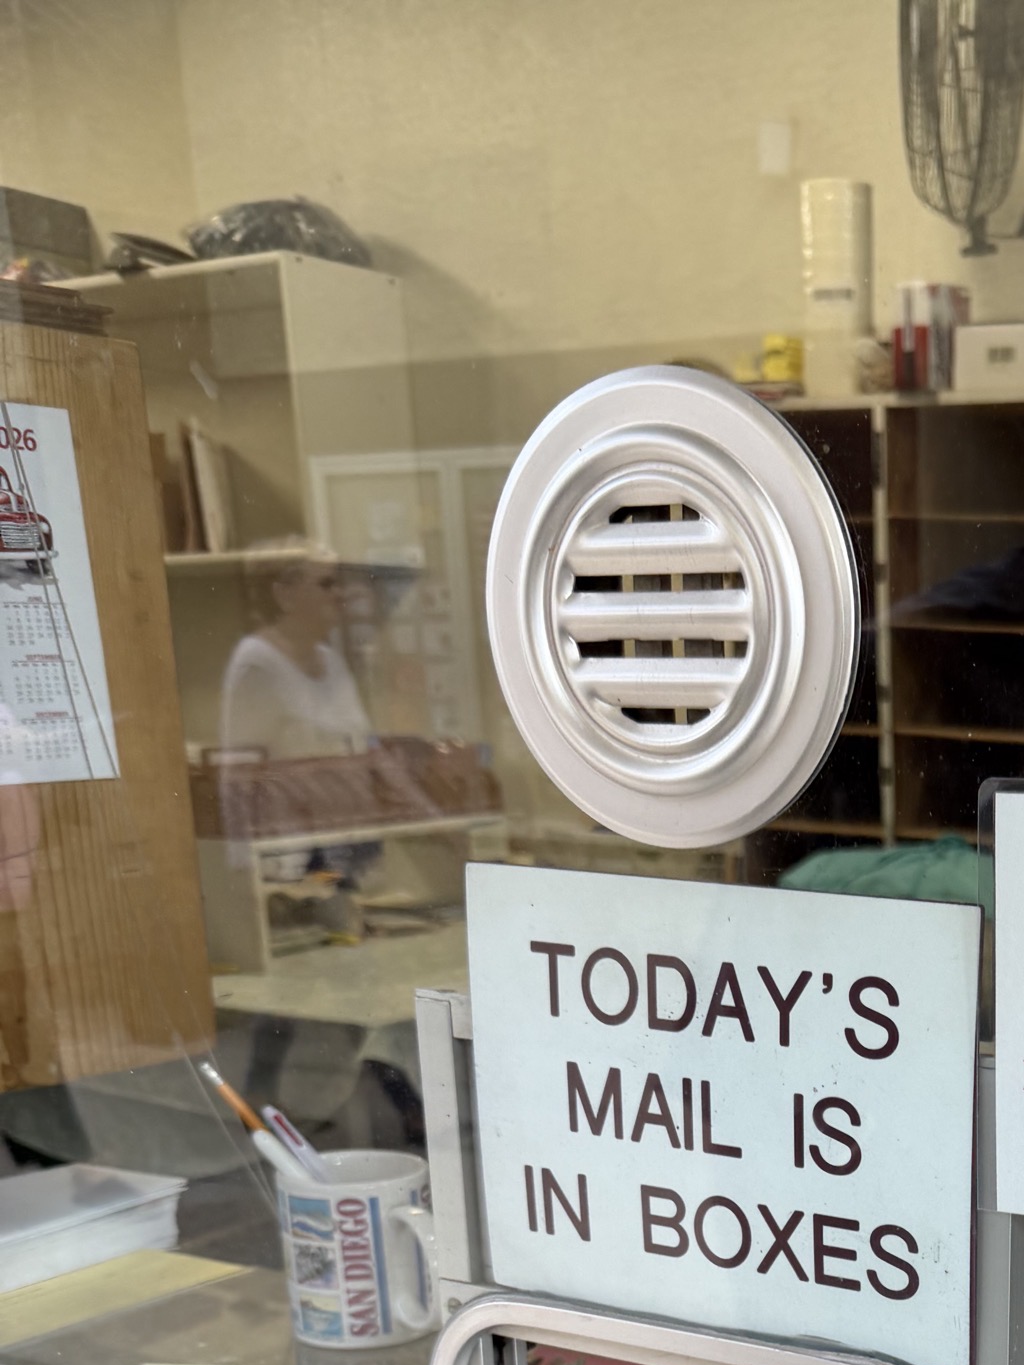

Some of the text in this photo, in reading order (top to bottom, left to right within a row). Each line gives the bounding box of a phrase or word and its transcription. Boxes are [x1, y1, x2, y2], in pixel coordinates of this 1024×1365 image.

[530, 941, 899, 1060] TODAY'S
[567, 1061, 861, 1176] MAIL IS
[336, 1198, 379, 1337] SAN DIEGO
[524, 1165, 919, 1300] IN BOXES
